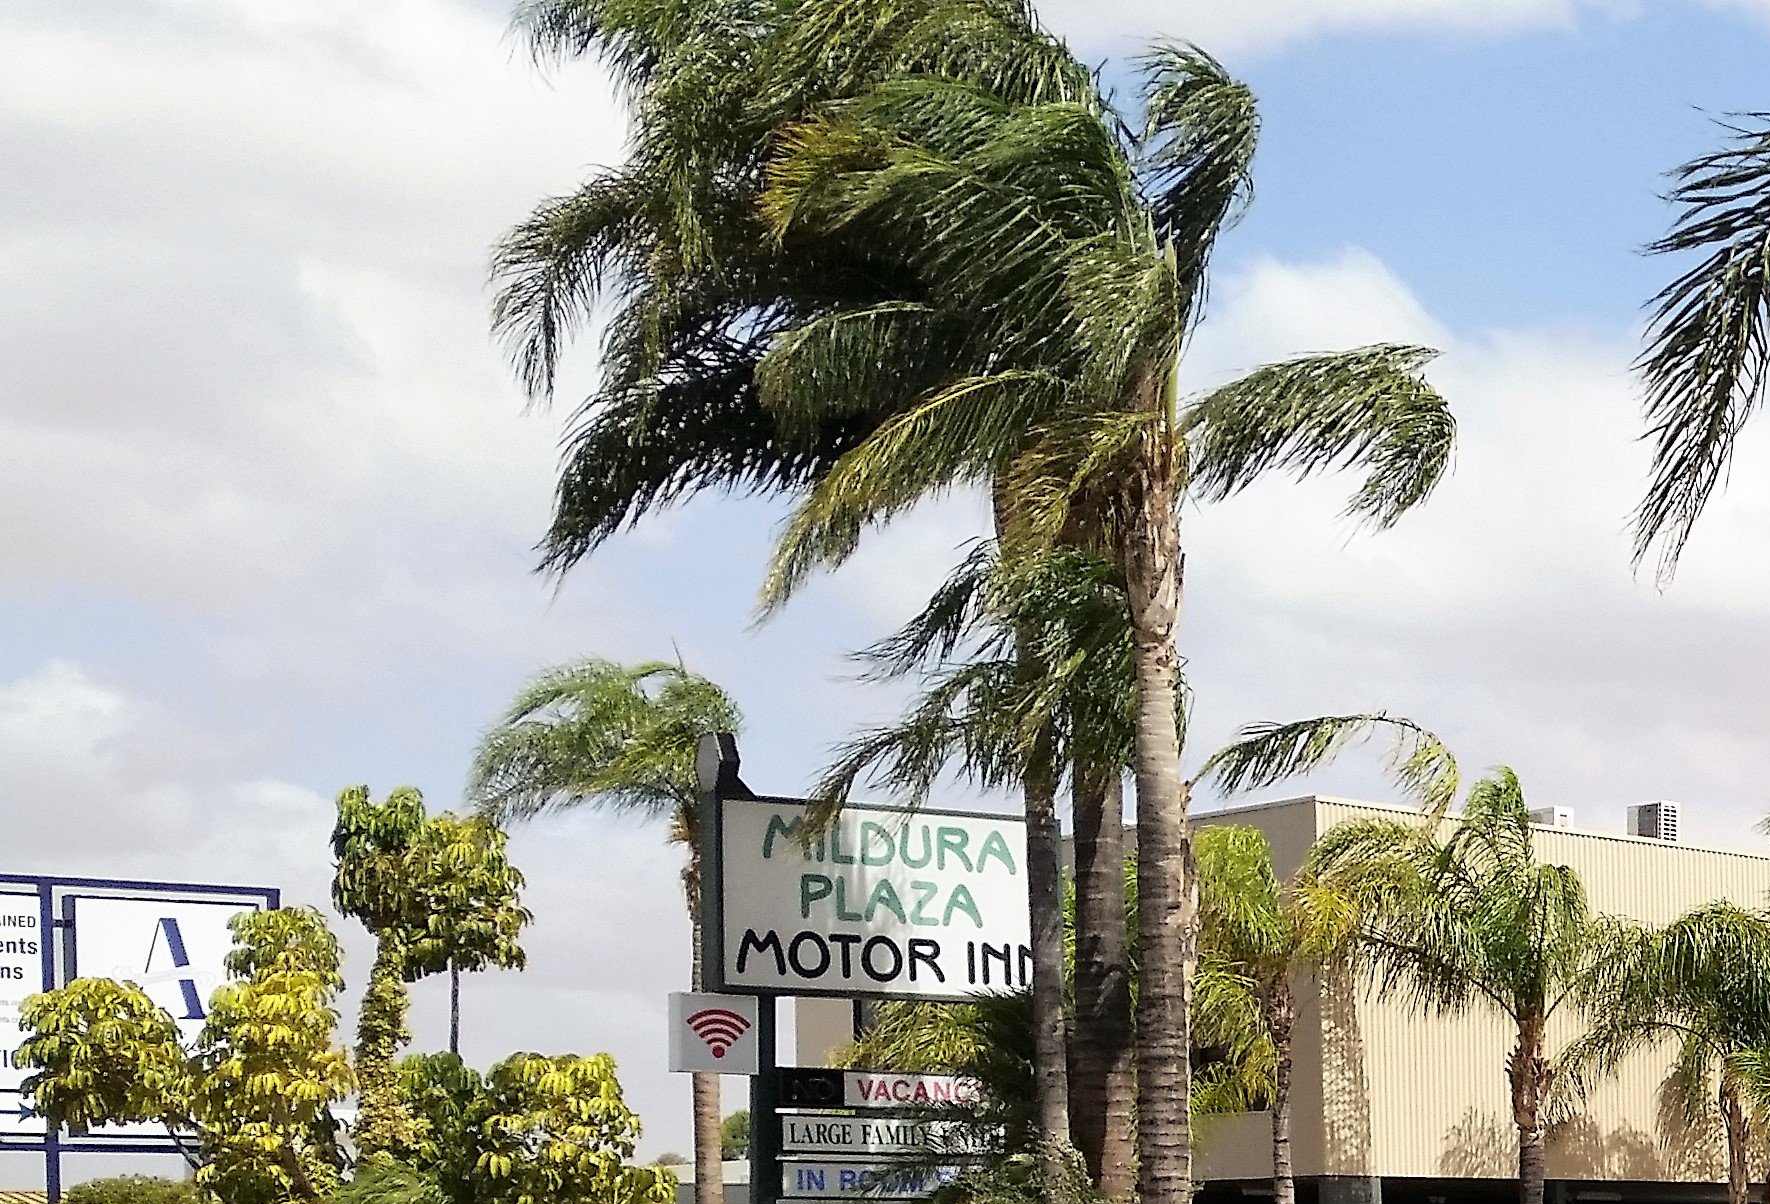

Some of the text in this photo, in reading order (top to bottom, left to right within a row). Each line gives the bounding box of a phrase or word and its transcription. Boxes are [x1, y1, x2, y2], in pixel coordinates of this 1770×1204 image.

[762, 814, 1016, 875] MILDURA
[800, 873, 983, 929] PLAZA
[736, 928, 945, 983] MOTOR
[789, 1122, 852, 1145] LARGE
[797, 1169, 826, 1191] IN
